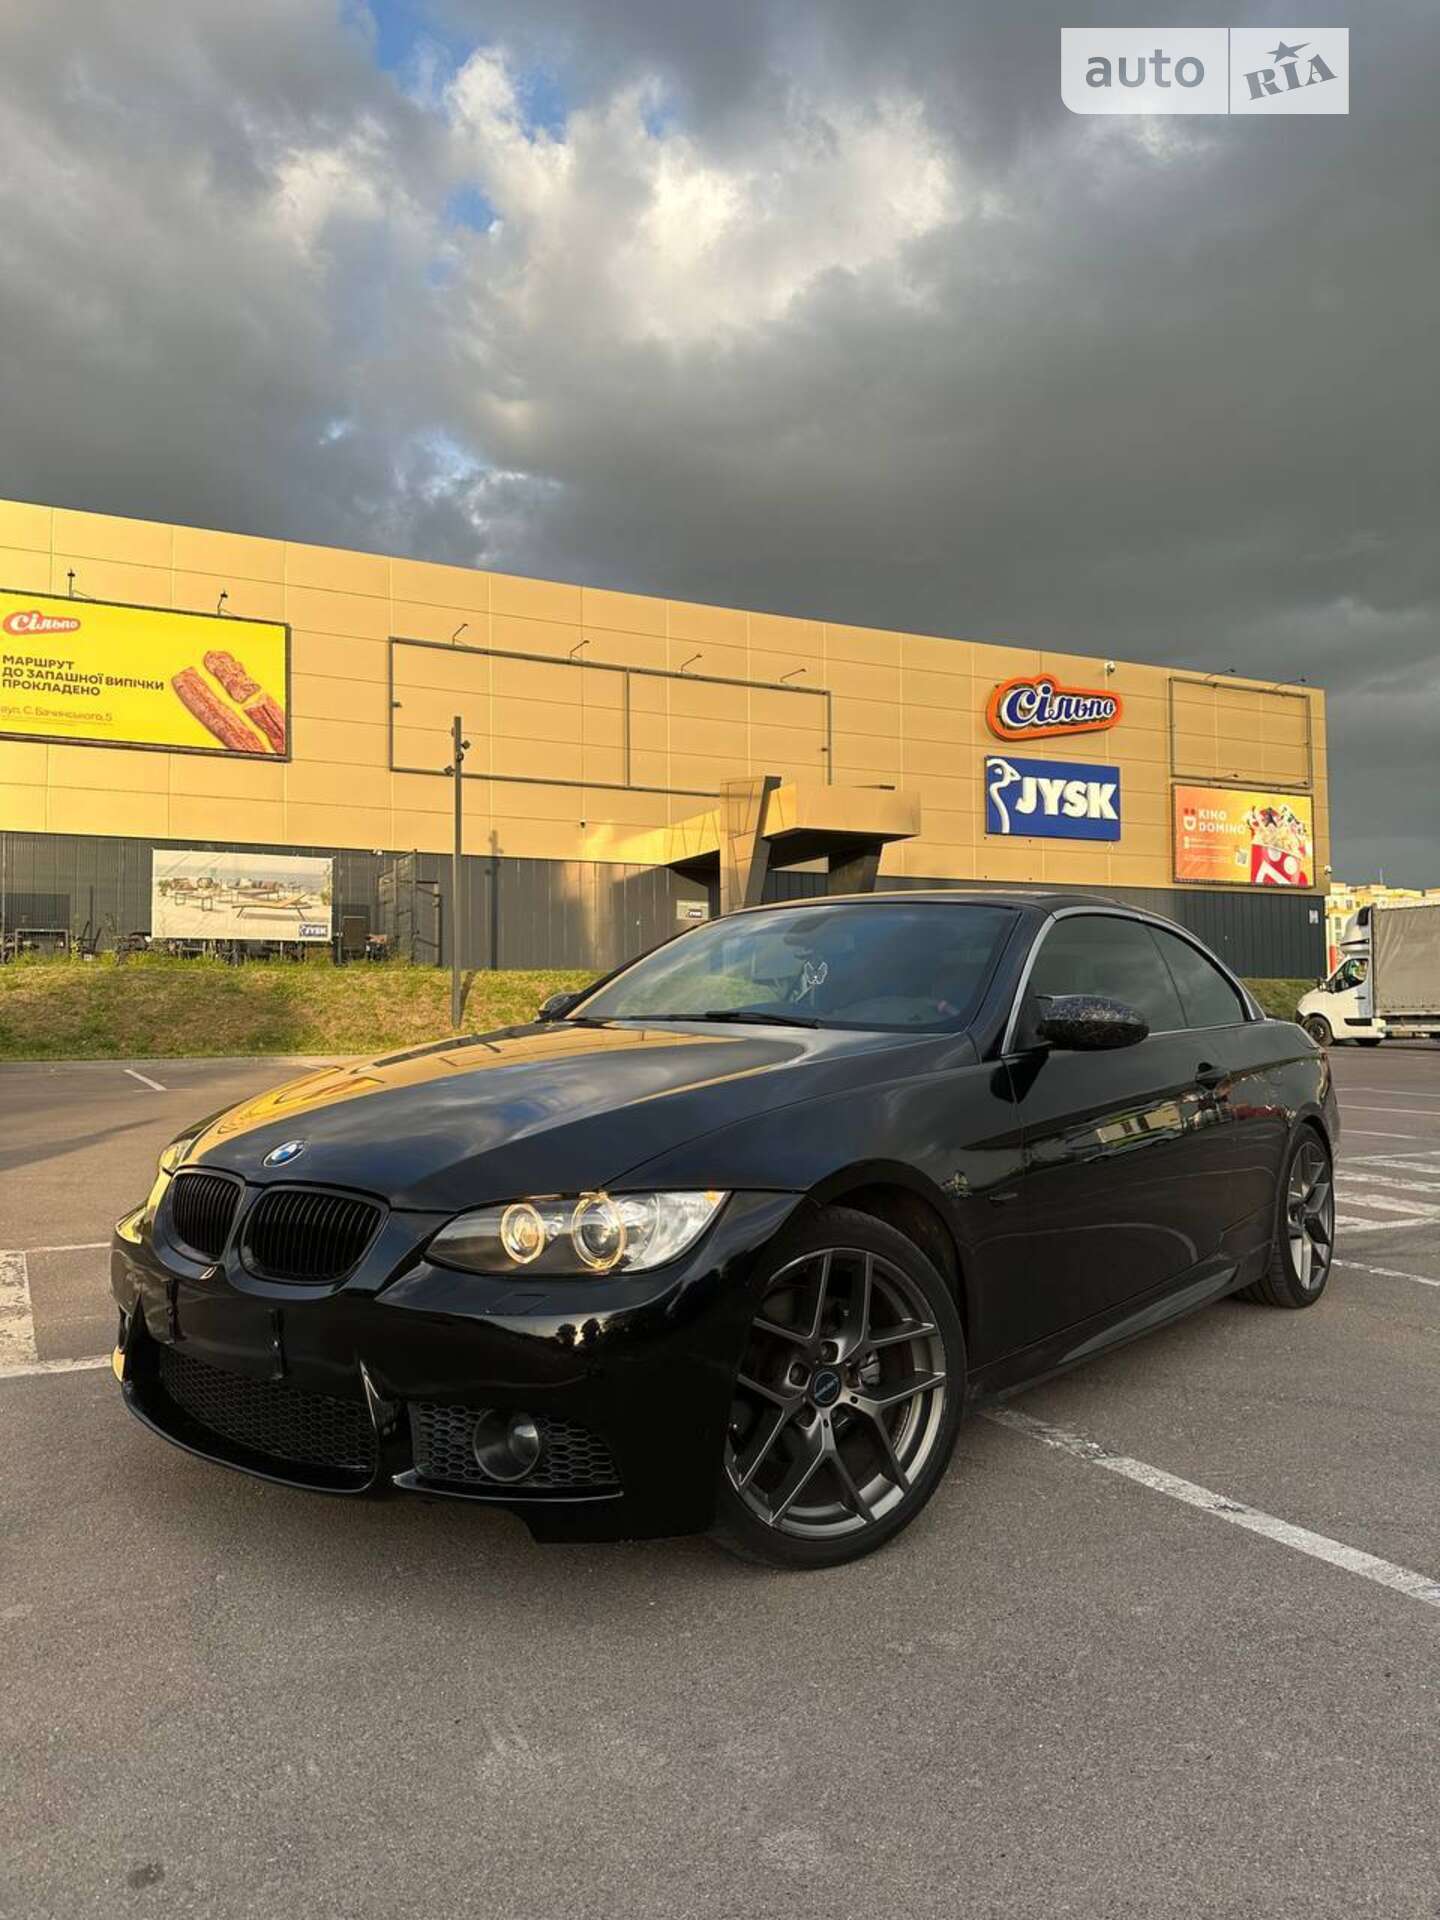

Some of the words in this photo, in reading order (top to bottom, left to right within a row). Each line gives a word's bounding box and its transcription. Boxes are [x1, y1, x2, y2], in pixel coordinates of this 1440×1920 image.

[10, 612, 79, 632] Сільпо
[2, 655, 75, 670] МАРШРУТ
[2, 666, 24, 678] ДО
[26, 669, 104, 684] ЗАПАШНОЇ
[105, 676, 165, 691] ВИПІЧКИ
[2, 679, 101, 696] ПРОКЛАДЕНО
[1000, 683, 1116, 727] Сільпо
[1015, 777, 1118, 820] JYSK
